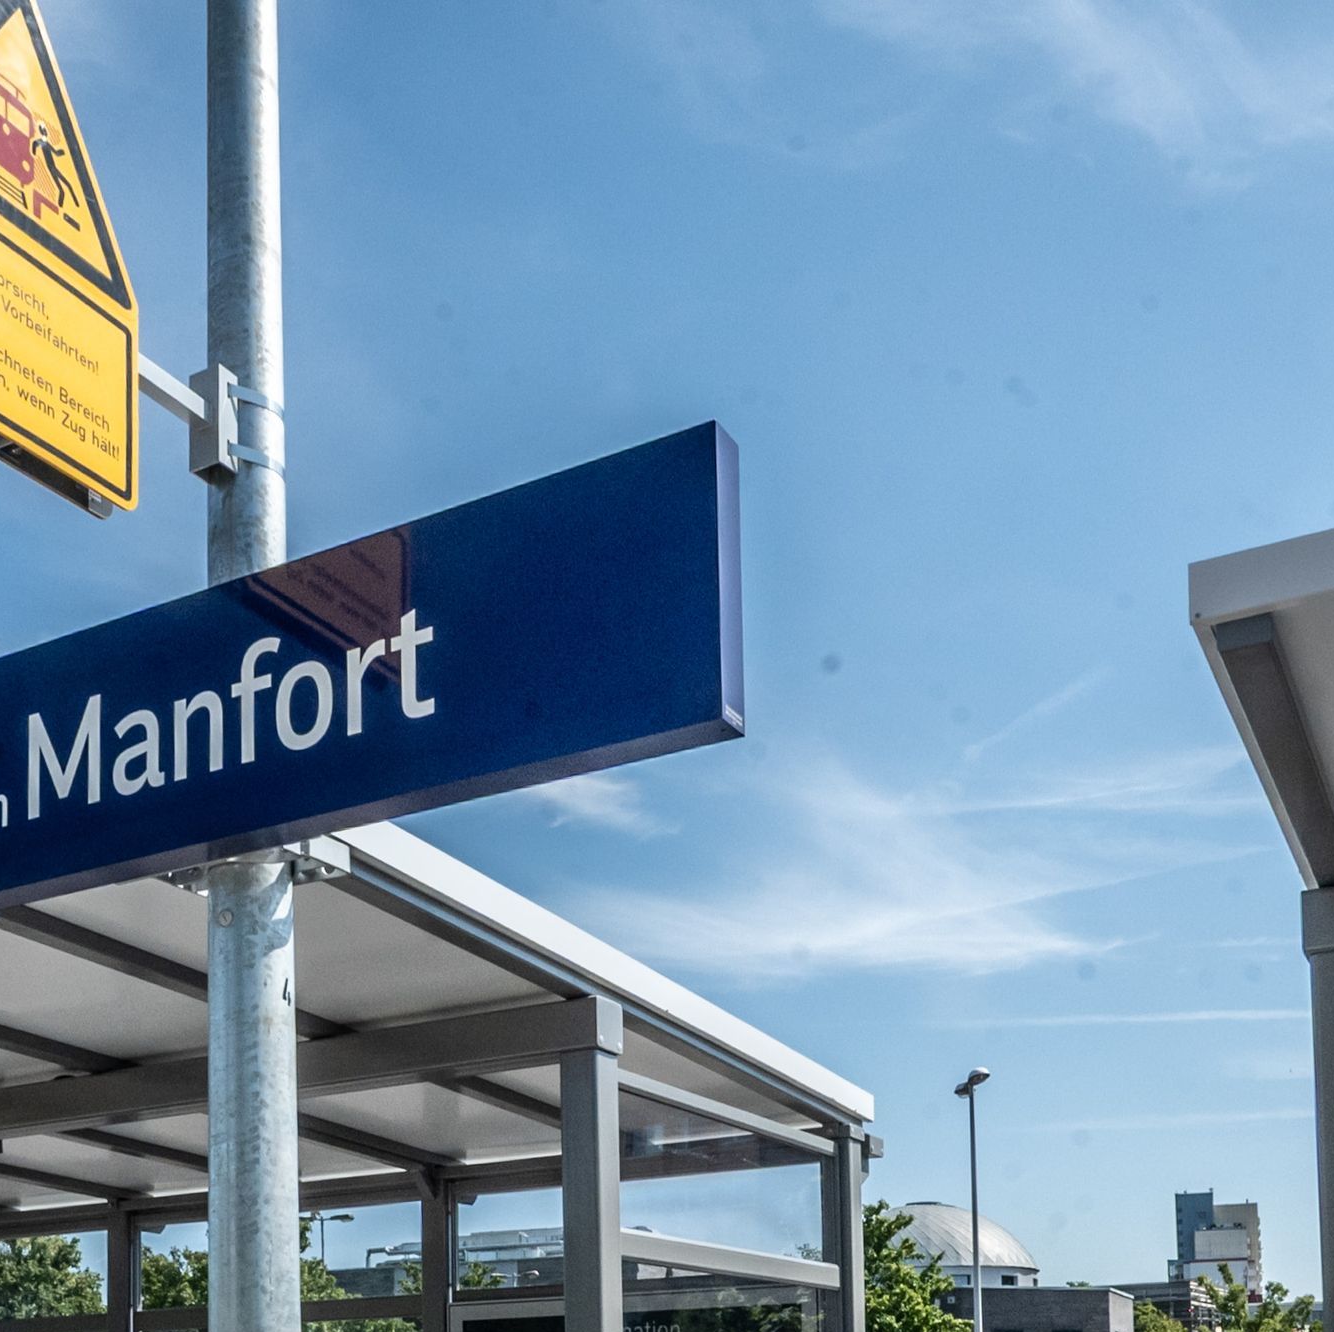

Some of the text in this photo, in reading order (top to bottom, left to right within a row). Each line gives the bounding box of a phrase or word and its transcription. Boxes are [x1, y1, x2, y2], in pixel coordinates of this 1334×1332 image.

[0, 294, 100, 377] Vorbeifahrten!
[16, 385, 56, 419] wenn
[60, 410, 87, 443] Zug
[91, 430, 120, 461] hält!
[58, 386, 111, 433] Bereich
[26, 608, 436, 821] Manfort
